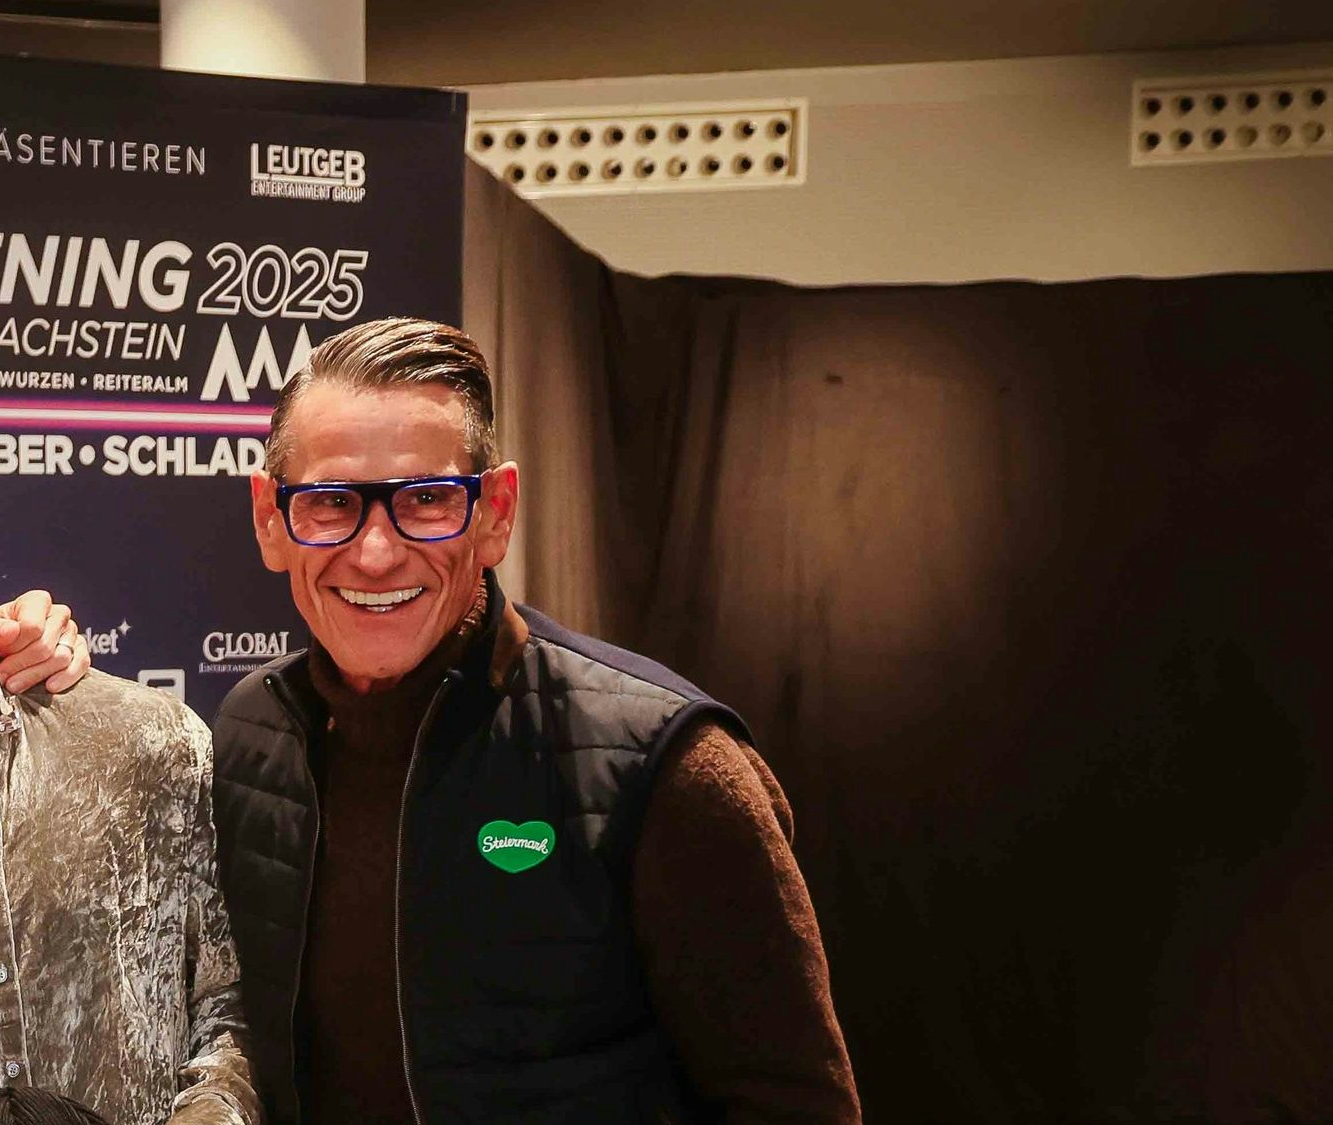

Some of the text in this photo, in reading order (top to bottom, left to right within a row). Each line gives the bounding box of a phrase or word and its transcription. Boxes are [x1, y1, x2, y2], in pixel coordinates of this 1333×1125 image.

[250, 143, 366, 187] LEUTGEB
[251, 180, 366, 203] ENTERTAINMENT GROUP
[197, 241, 369, 321] 2025
[93, 373, 189, 392] REITERALM
[102, 435, 267, 477] SCHLAD
[86, 627, 119, 654] ket
[482, 836, 548, 854] Steiermark
